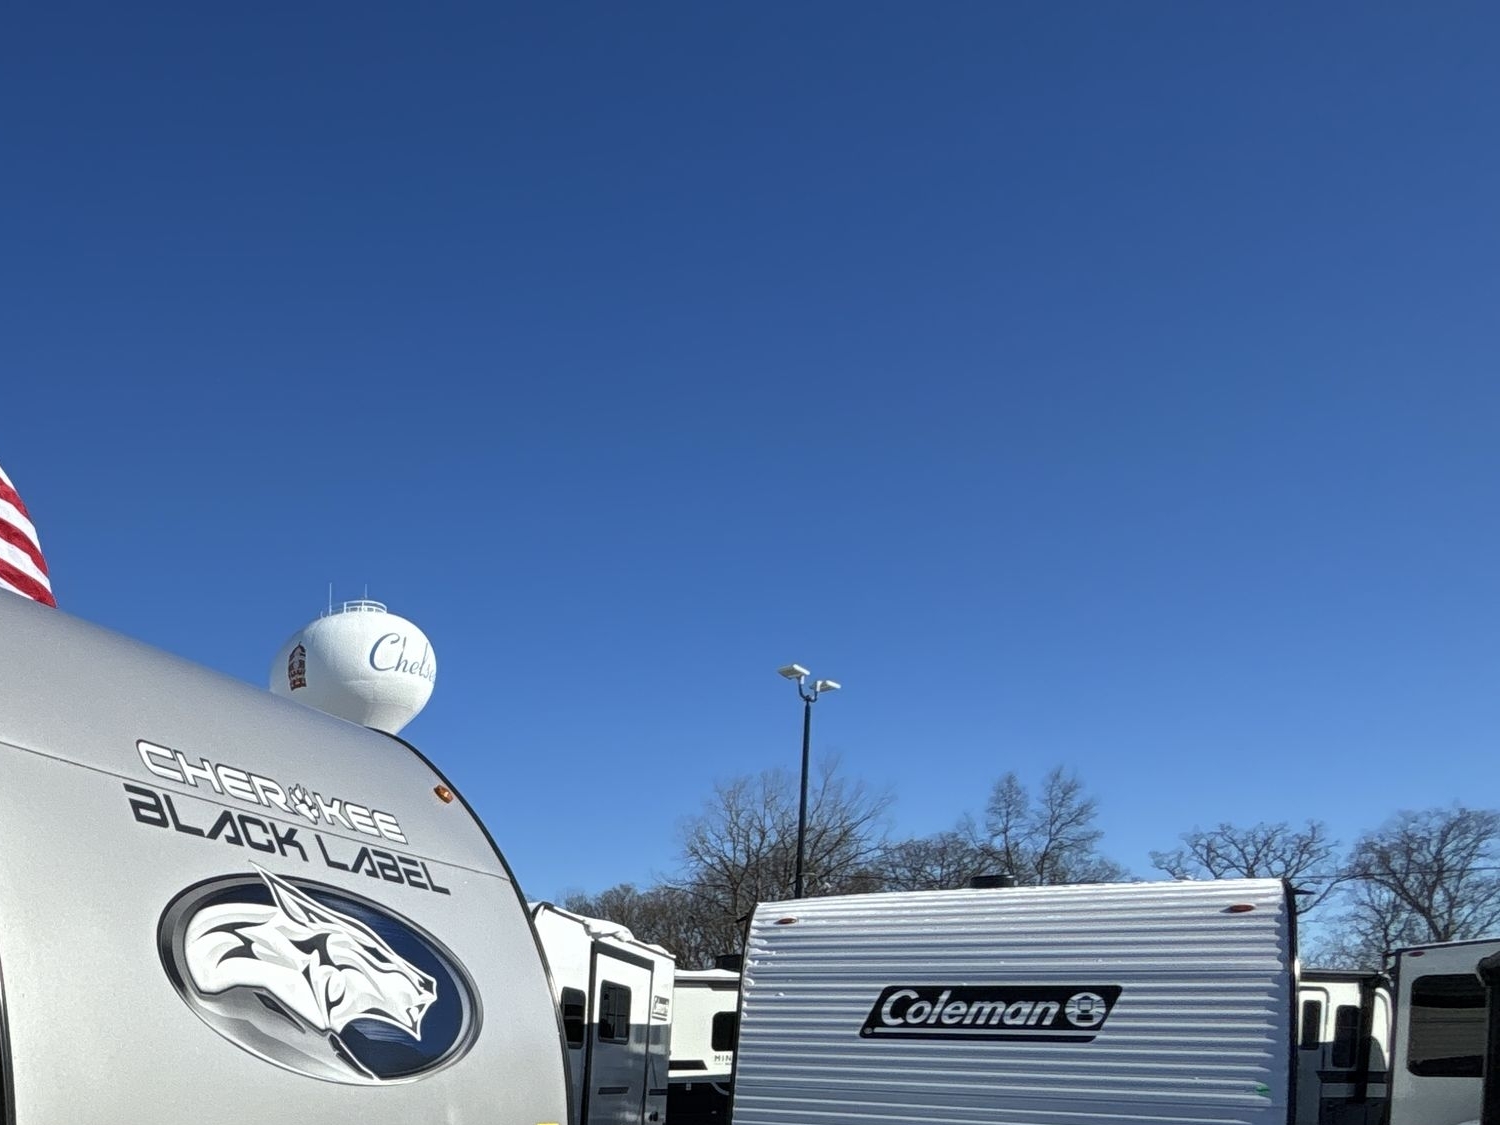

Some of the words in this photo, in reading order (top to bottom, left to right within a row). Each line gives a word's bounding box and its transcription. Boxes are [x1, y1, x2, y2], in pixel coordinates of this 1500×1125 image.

[123, 783, 309, 863] BLACK
[315, 833, 451, 896] LABEL
[881, 988, 1061, 1026] Coleman
